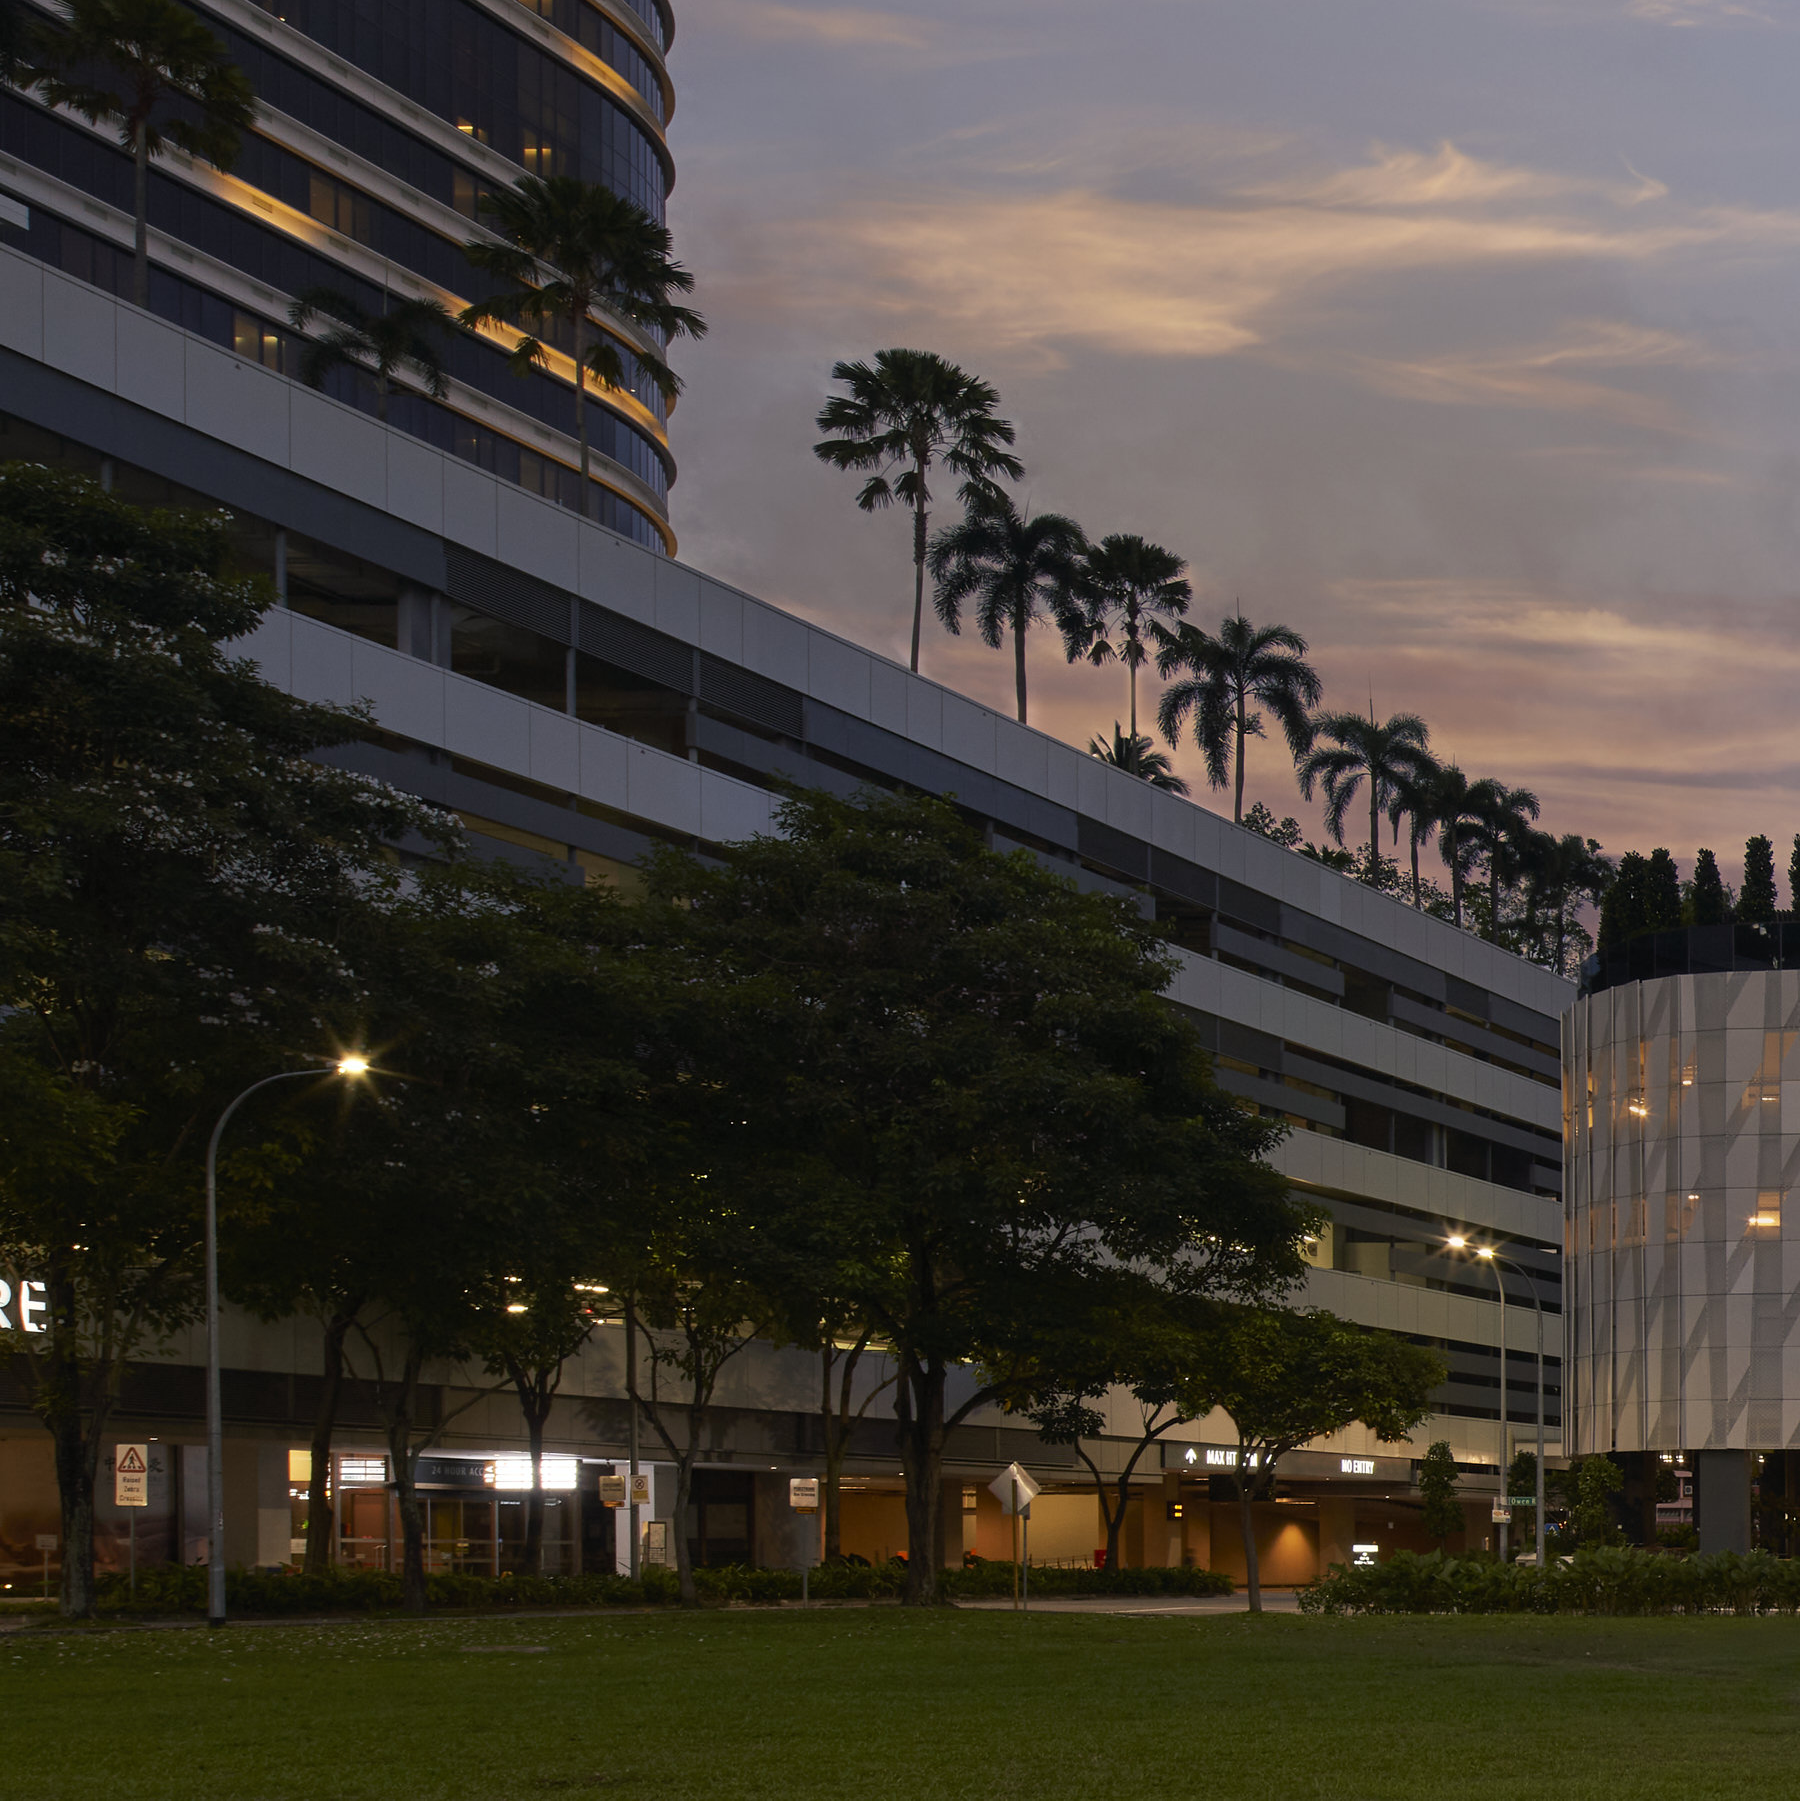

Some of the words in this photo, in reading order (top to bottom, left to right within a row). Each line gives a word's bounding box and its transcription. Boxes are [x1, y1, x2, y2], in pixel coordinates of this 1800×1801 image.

[1206, 1449, 1225, 1465] MAX
[1226, 1450, 1238, 1466] HT
[444, 1466, 467, 1475] HOUR
[1341, 1459, 1353, 1473] NO
[1353, 1460, 1375, 1475] ENTRY
